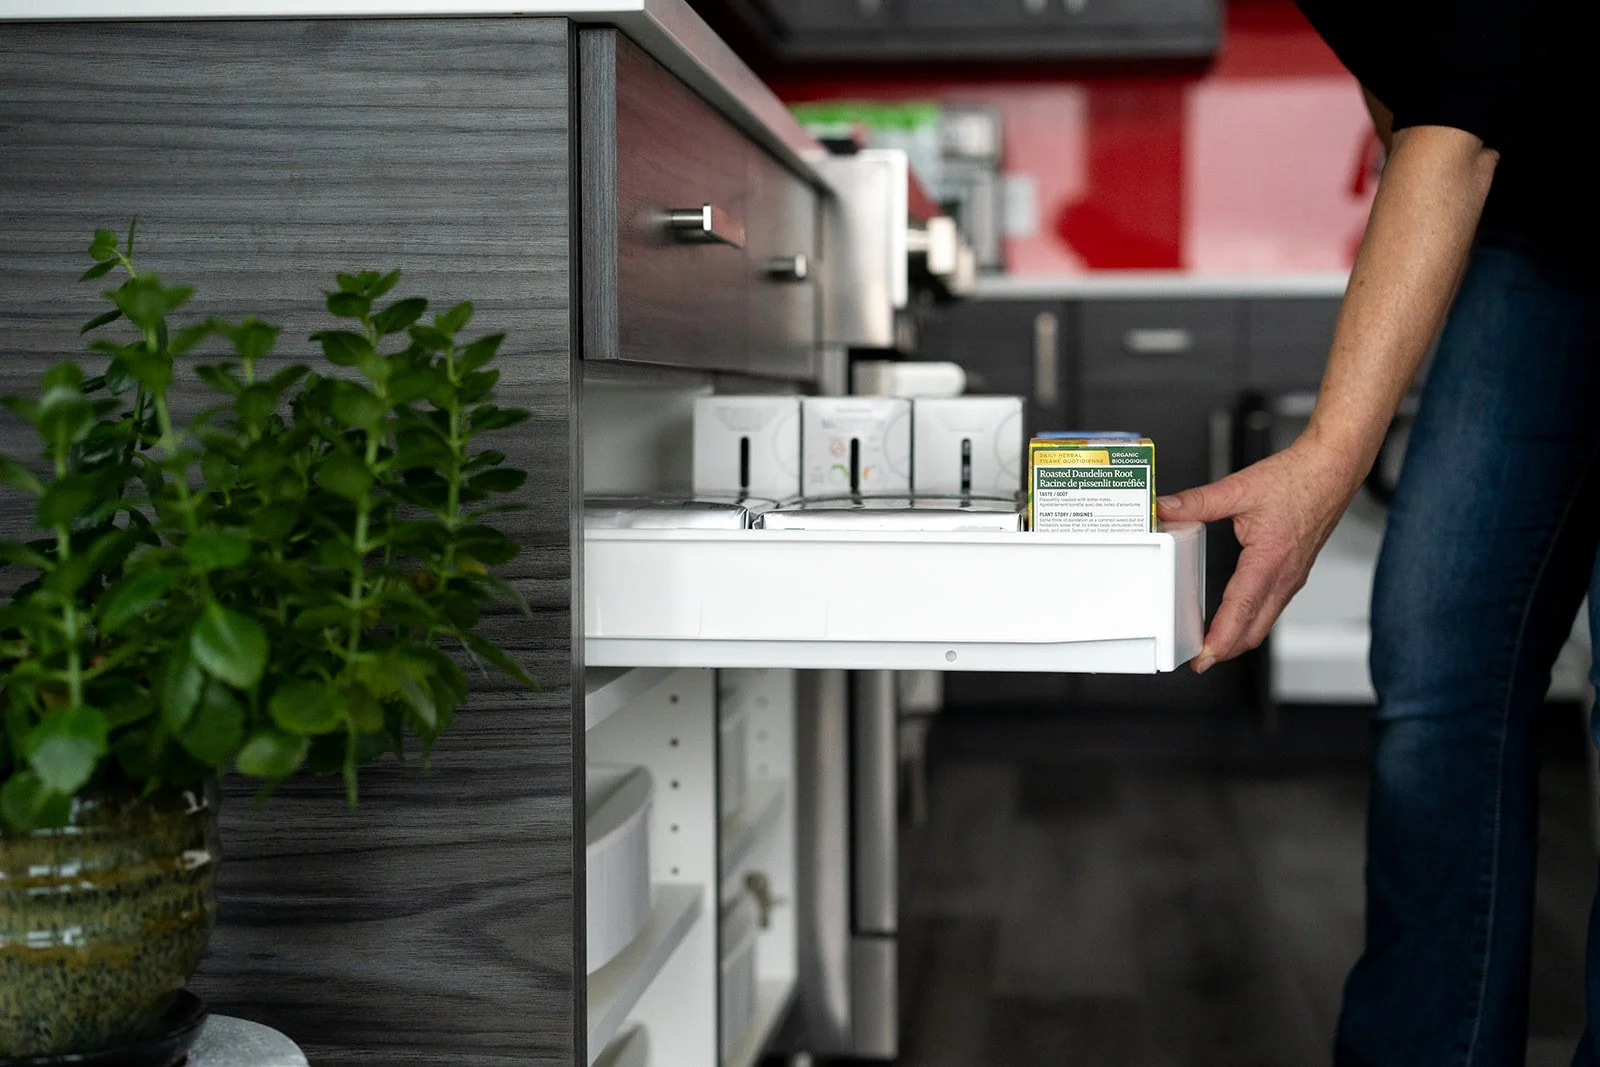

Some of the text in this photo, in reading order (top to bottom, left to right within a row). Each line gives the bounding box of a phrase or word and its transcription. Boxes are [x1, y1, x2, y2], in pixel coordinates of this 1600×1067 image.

[1040, 469, 1133, 478] Roasted Dandelion Root
[1040, 479, 1145, 489] Racine de pissenlit torréfiée
